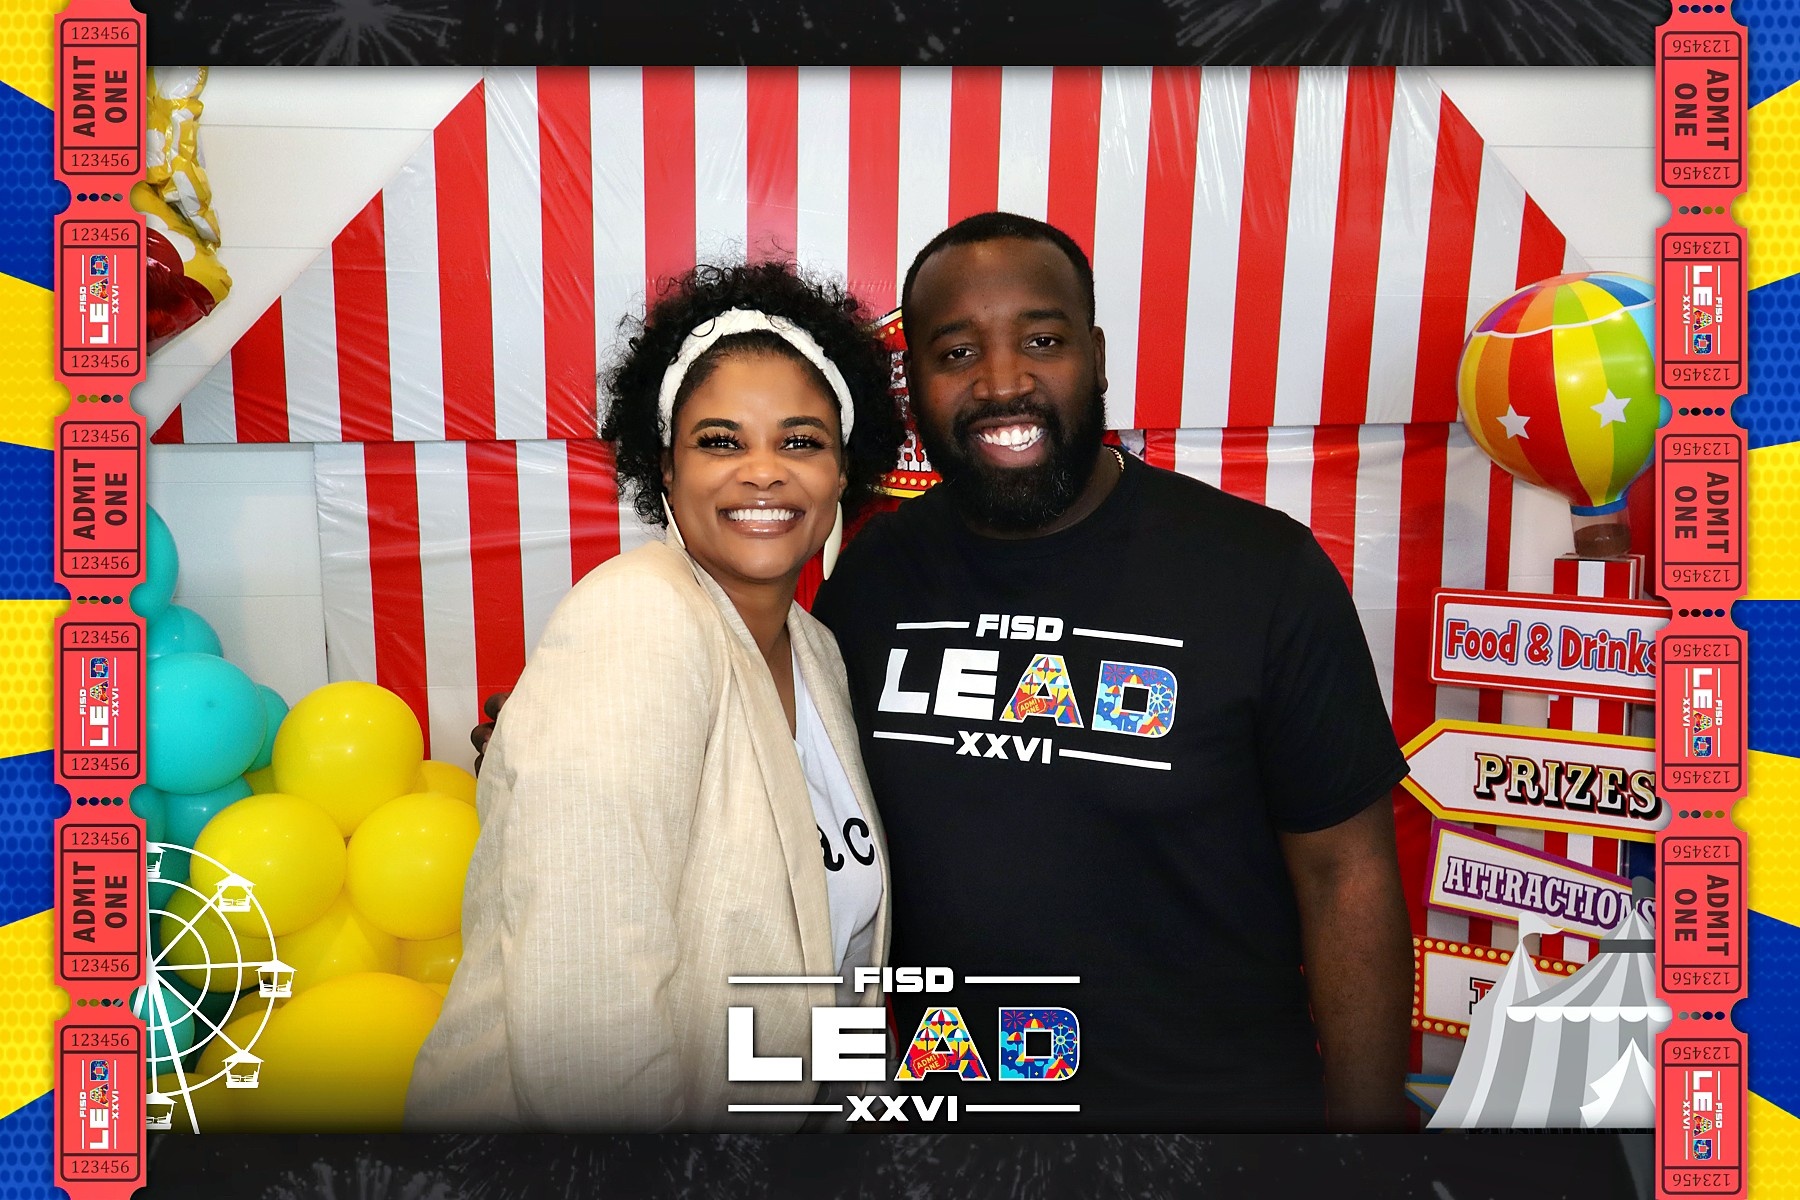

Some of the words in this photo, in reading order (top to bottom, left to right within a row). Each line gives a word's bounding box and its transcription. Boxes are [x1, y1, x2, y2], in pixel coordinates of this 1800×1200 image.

[975, 613, 1064, 642] FISD
[1447, 618, 1522, 666] Food
[1526, 622, 1553, 666] &
[877, 648, 1179, 739] LEAD
[956, 730, 1053, 765] XXVI
[1474, 752, 1663, 821] PRIZES
